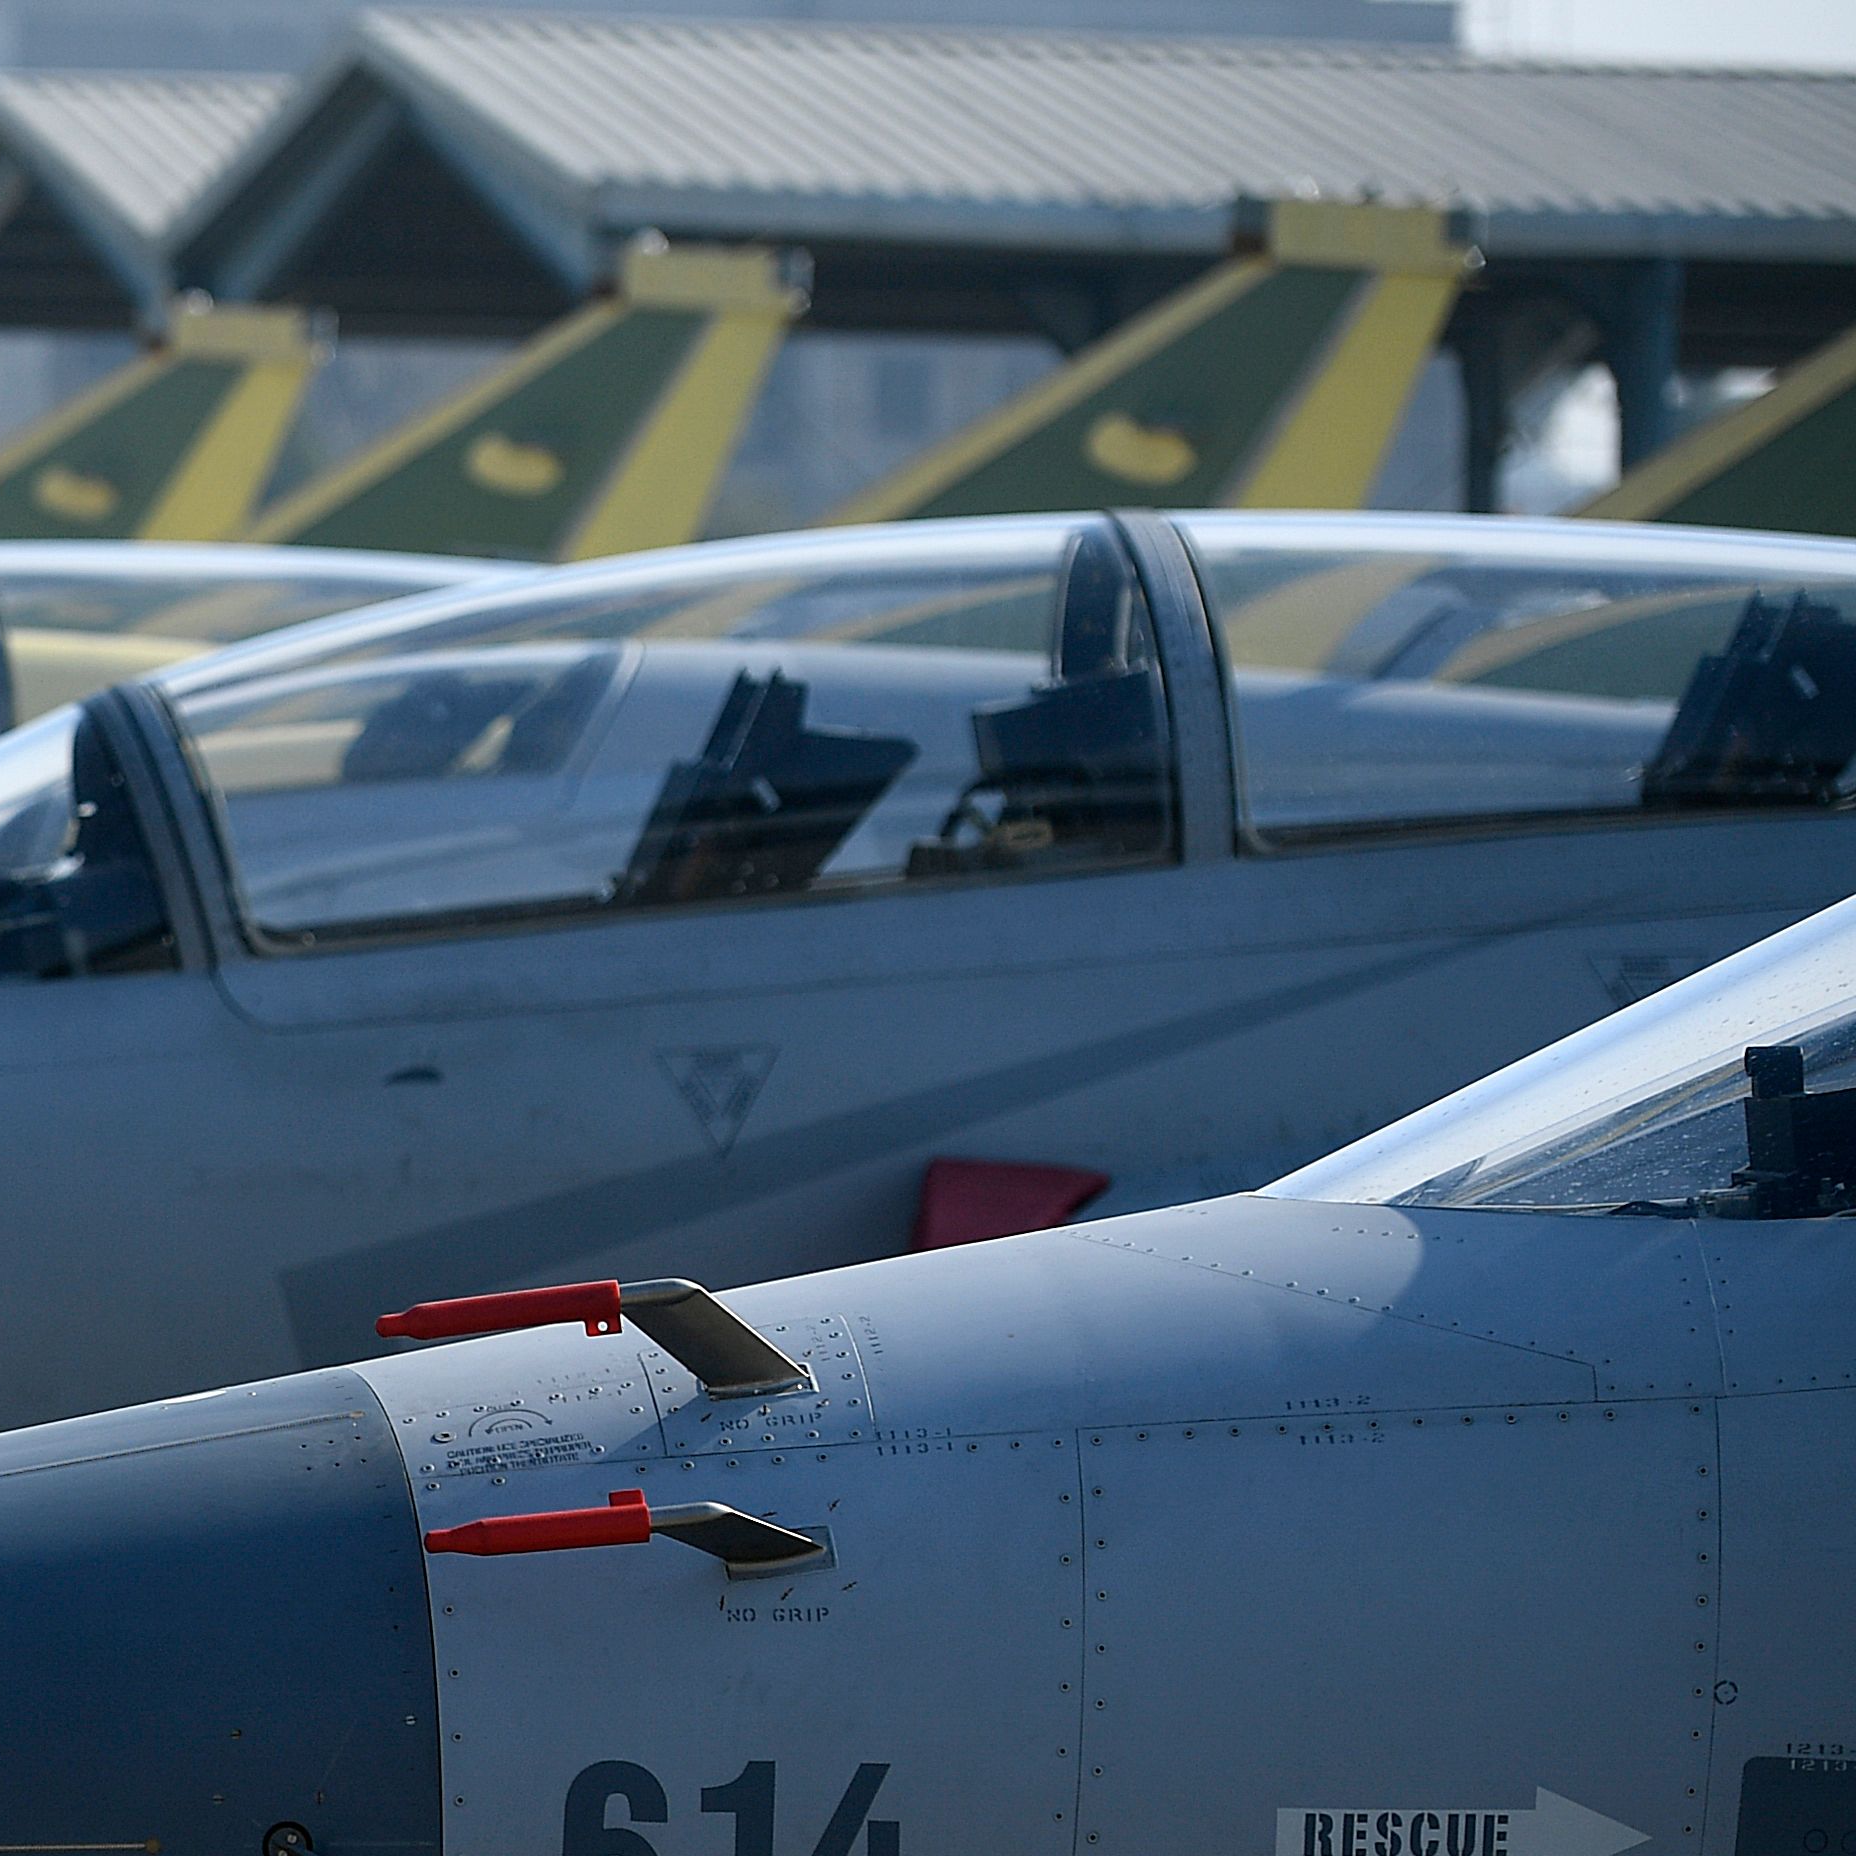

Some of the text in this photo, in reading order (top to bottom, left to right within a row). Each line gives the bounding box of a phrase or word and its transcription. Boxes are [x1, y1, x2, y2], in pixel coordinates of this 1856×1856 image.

[719, 1411, 823, 1432] NO GRIP
[727, 1606, 830, 1623] NO GRIP
